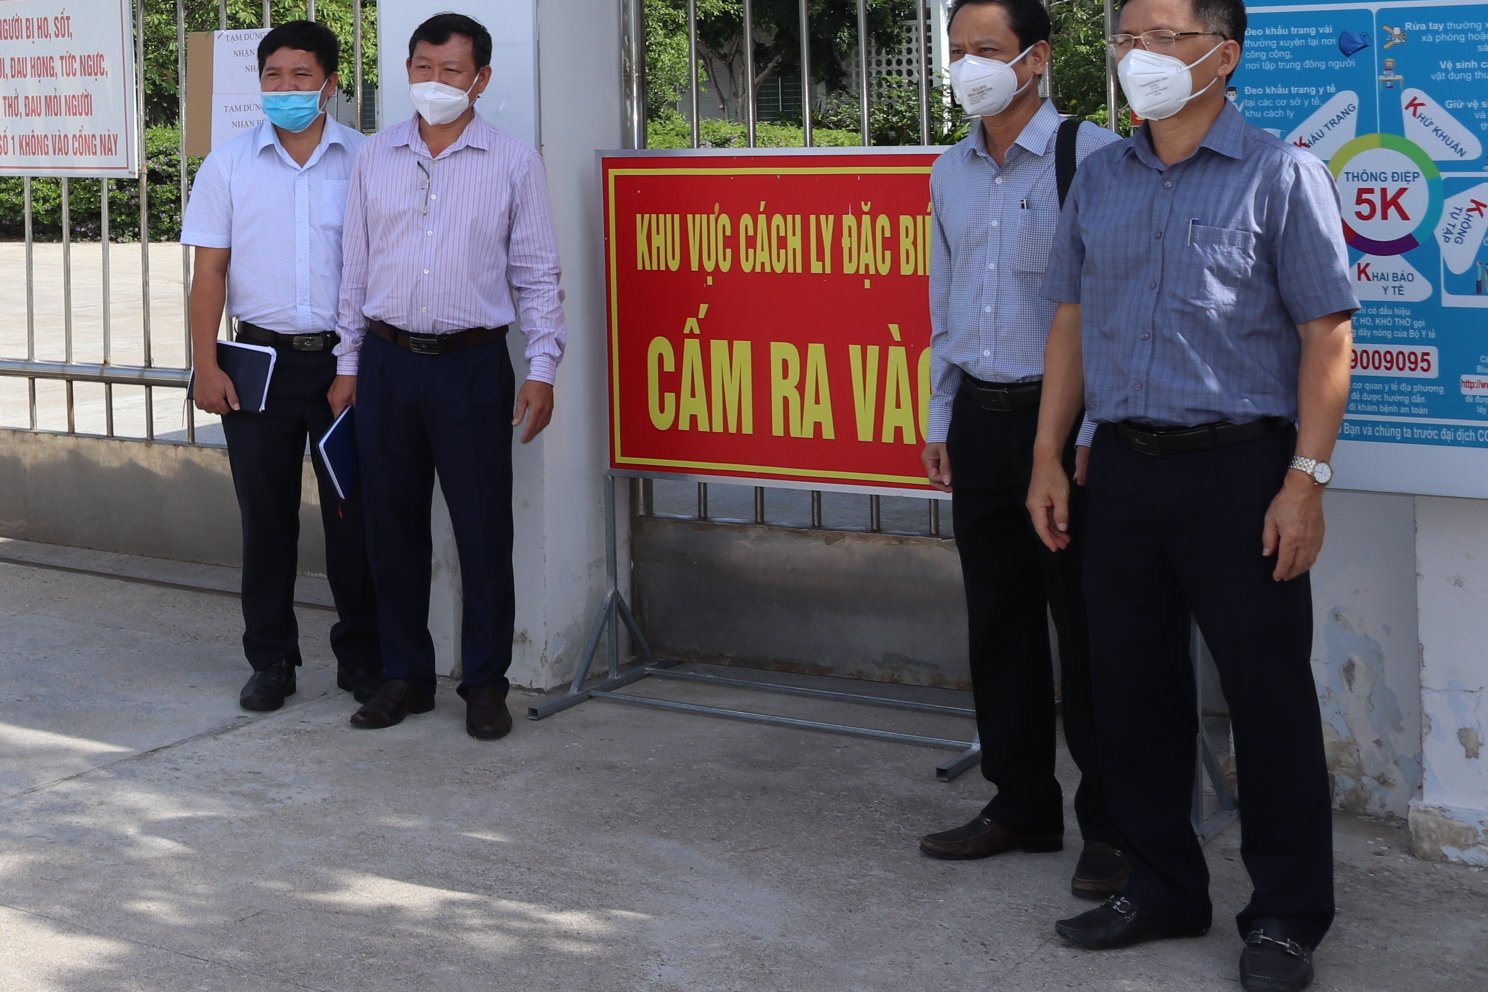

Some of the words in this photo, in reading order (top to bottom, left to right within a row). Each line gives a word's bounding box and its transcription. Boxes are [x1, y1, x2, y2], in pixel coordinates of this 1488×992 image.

[25, 17, 35, 44] BỊ
[37, 16, 52, 41] HO,
[53, 8, 73, 40] SỐT,
[1291, 26, 1316, 36] trang
[1428, 21, 1444, 32] tay
[1308, 37, 1319, 47] tại
[10, 56, 28, 79] ĐAU
[30, 56, 58, 83] HỌNG,
[59, 51, 77, 77] TỨC
[1262, 59, 1276, 71] tập
[1278, 60, 1301, 71] trung
[1455, 59, 1478, 69] sinh
[1291, 85, 1316, 96] trang
[1318, 86, 1325, 95] y
[1326, 83, 1336, 94] tế
[24, 95, 42, 117] ĐAU
[64, 89, 93, 117] NGƯỜI
[1257, 98, 1274, 107] các
[1303, 99, 1310, 108] y
[1245, 109, 1261, 118] khu
[1263, 108, 1284, 118] cách
[1323, 103, 1357, 131] TRANG
[11, 134, 16, 156] 1
[18, 130, 49, 156] KHÔNG
[51, 129, 69, 156] VÀO
[72, 125, 97, 156] CỔNG
[99, 128, 119, 156] NÀY
[1344, 168, 1388, 183] THÔNG
[1391, 170, 1420, 185] ĐIỆP
[1354, 187, 1411, 221] 5K
[636, 213, 680, 272] KHU
[686, 202, 732, 286] VỰC
[739, 200, 803, 274] CÁCH
[809, 214, 834, 274] LY
[841, 201, 892, 289] ĐẶC
[1357, 263, 1390, 282] KHAI
[1392, 270, 1415, 283] BÁO
[1382, 286, 1389, 295] Y
[1391, 283, 1405, 296] TẾ
[1421, 330, 1428, 338] Y
[1351, 349, 1431, 373] 9009095
[647, 303, 754, 435] CẤM
[770, 341, 836, 440] RA
[1364, 383, 1383, 392] quan
[1384, 384, 1390, 392] y
[1344, 422, 1361, 438] Bạn
[1362, 424, 1372, 436] và
[1374, 424, 1401, 440] chúng
[1403, 427, 1412, 438] ta
[1456, 428, 1477, 444] dịch
